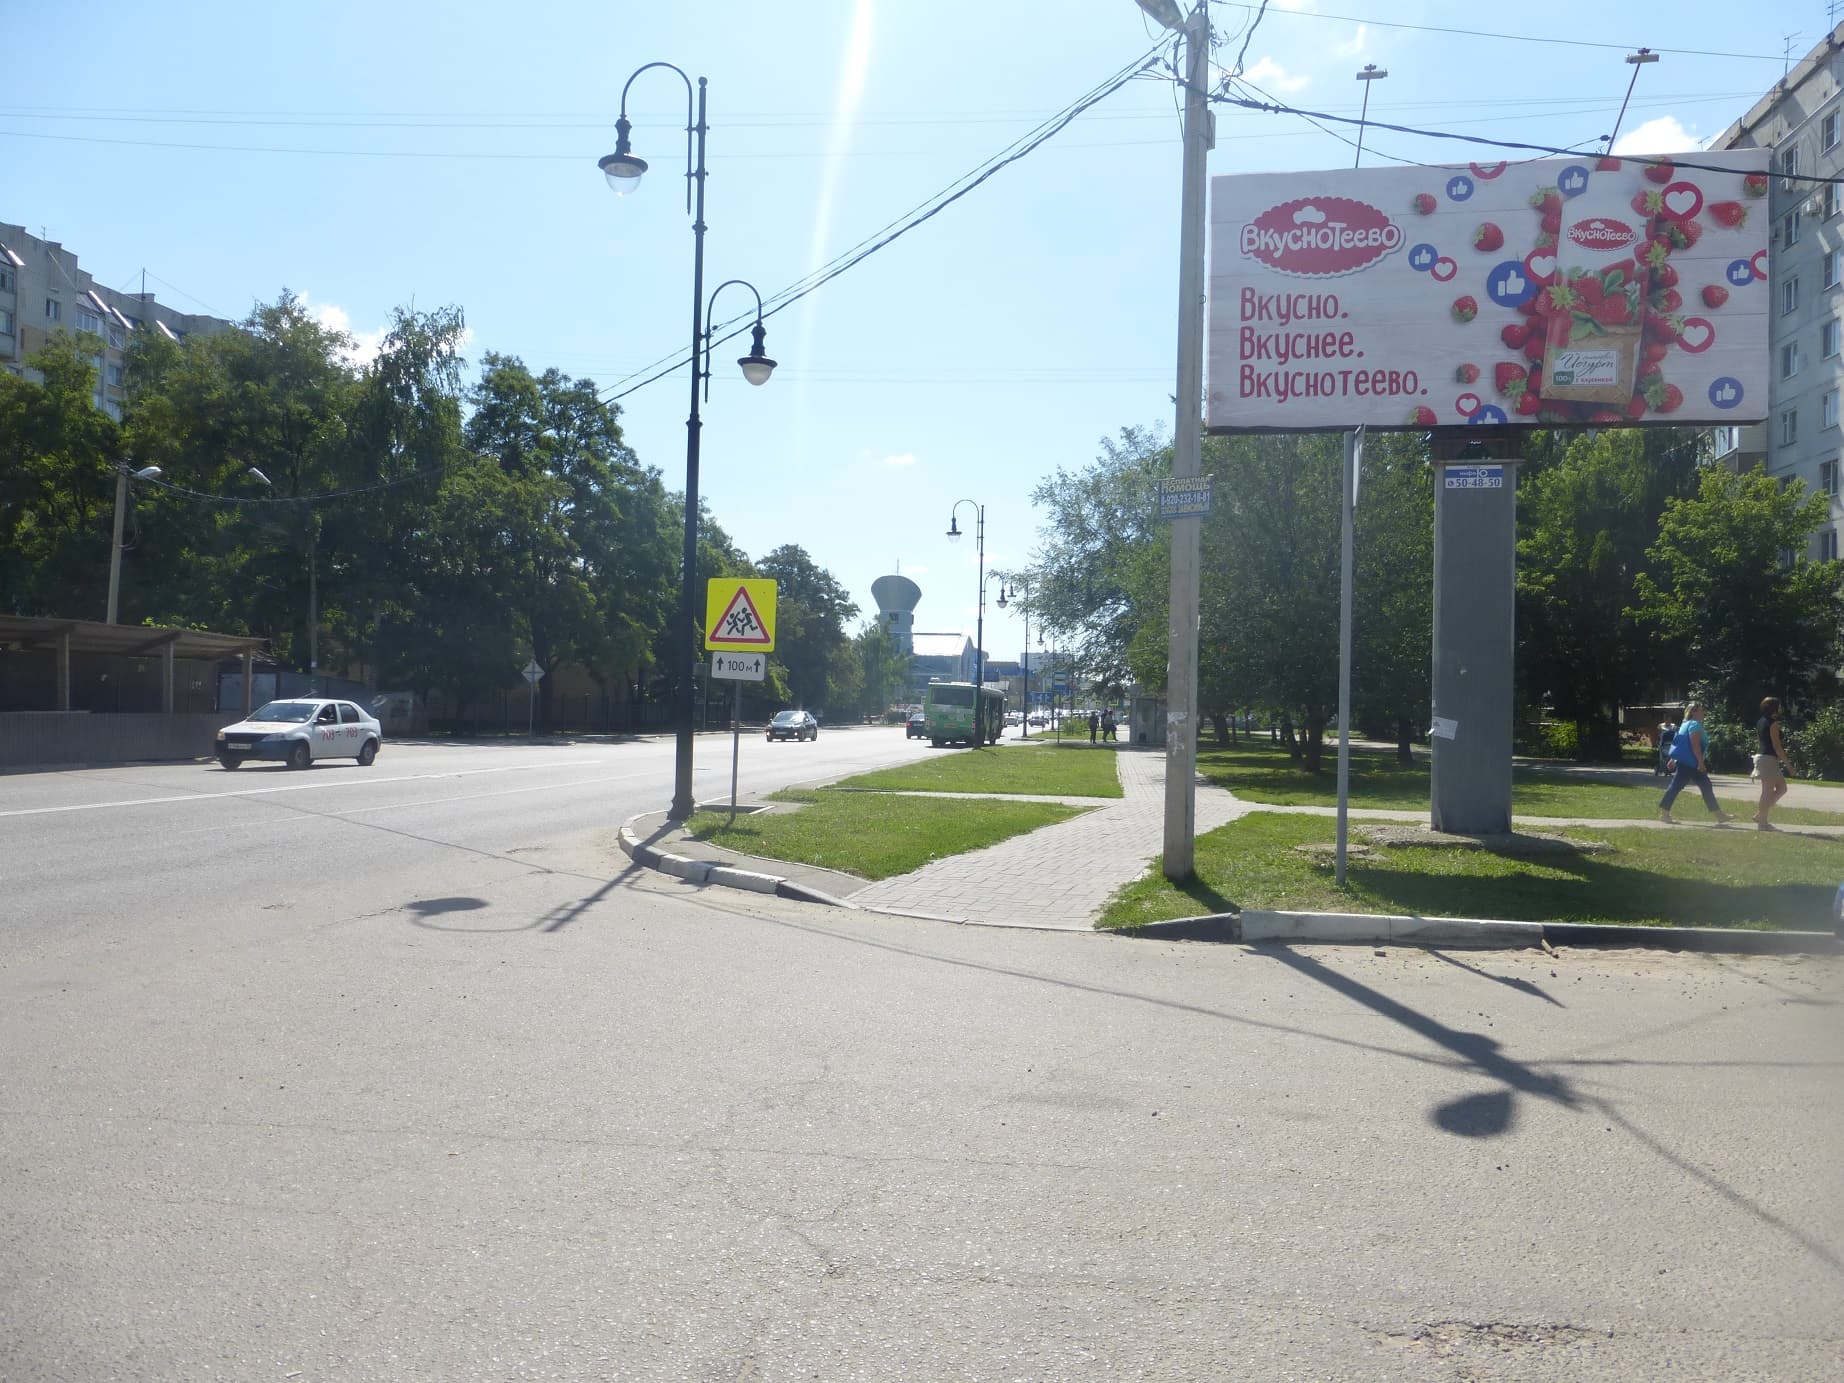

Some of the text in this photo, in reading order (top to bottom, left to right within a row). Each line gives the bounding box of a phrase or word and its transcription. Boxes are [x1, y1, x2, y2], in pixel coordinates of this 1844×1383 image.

[1240, 286, 1349, 326] Вкусно.
[1239, 325, 1364, 365] Вкуснее.
[1239, 364, 1428, 404] Вкуснотеево.
[1456, 479, 1500, 487] 50-48-50
[727, 660, 745, 672] 100
